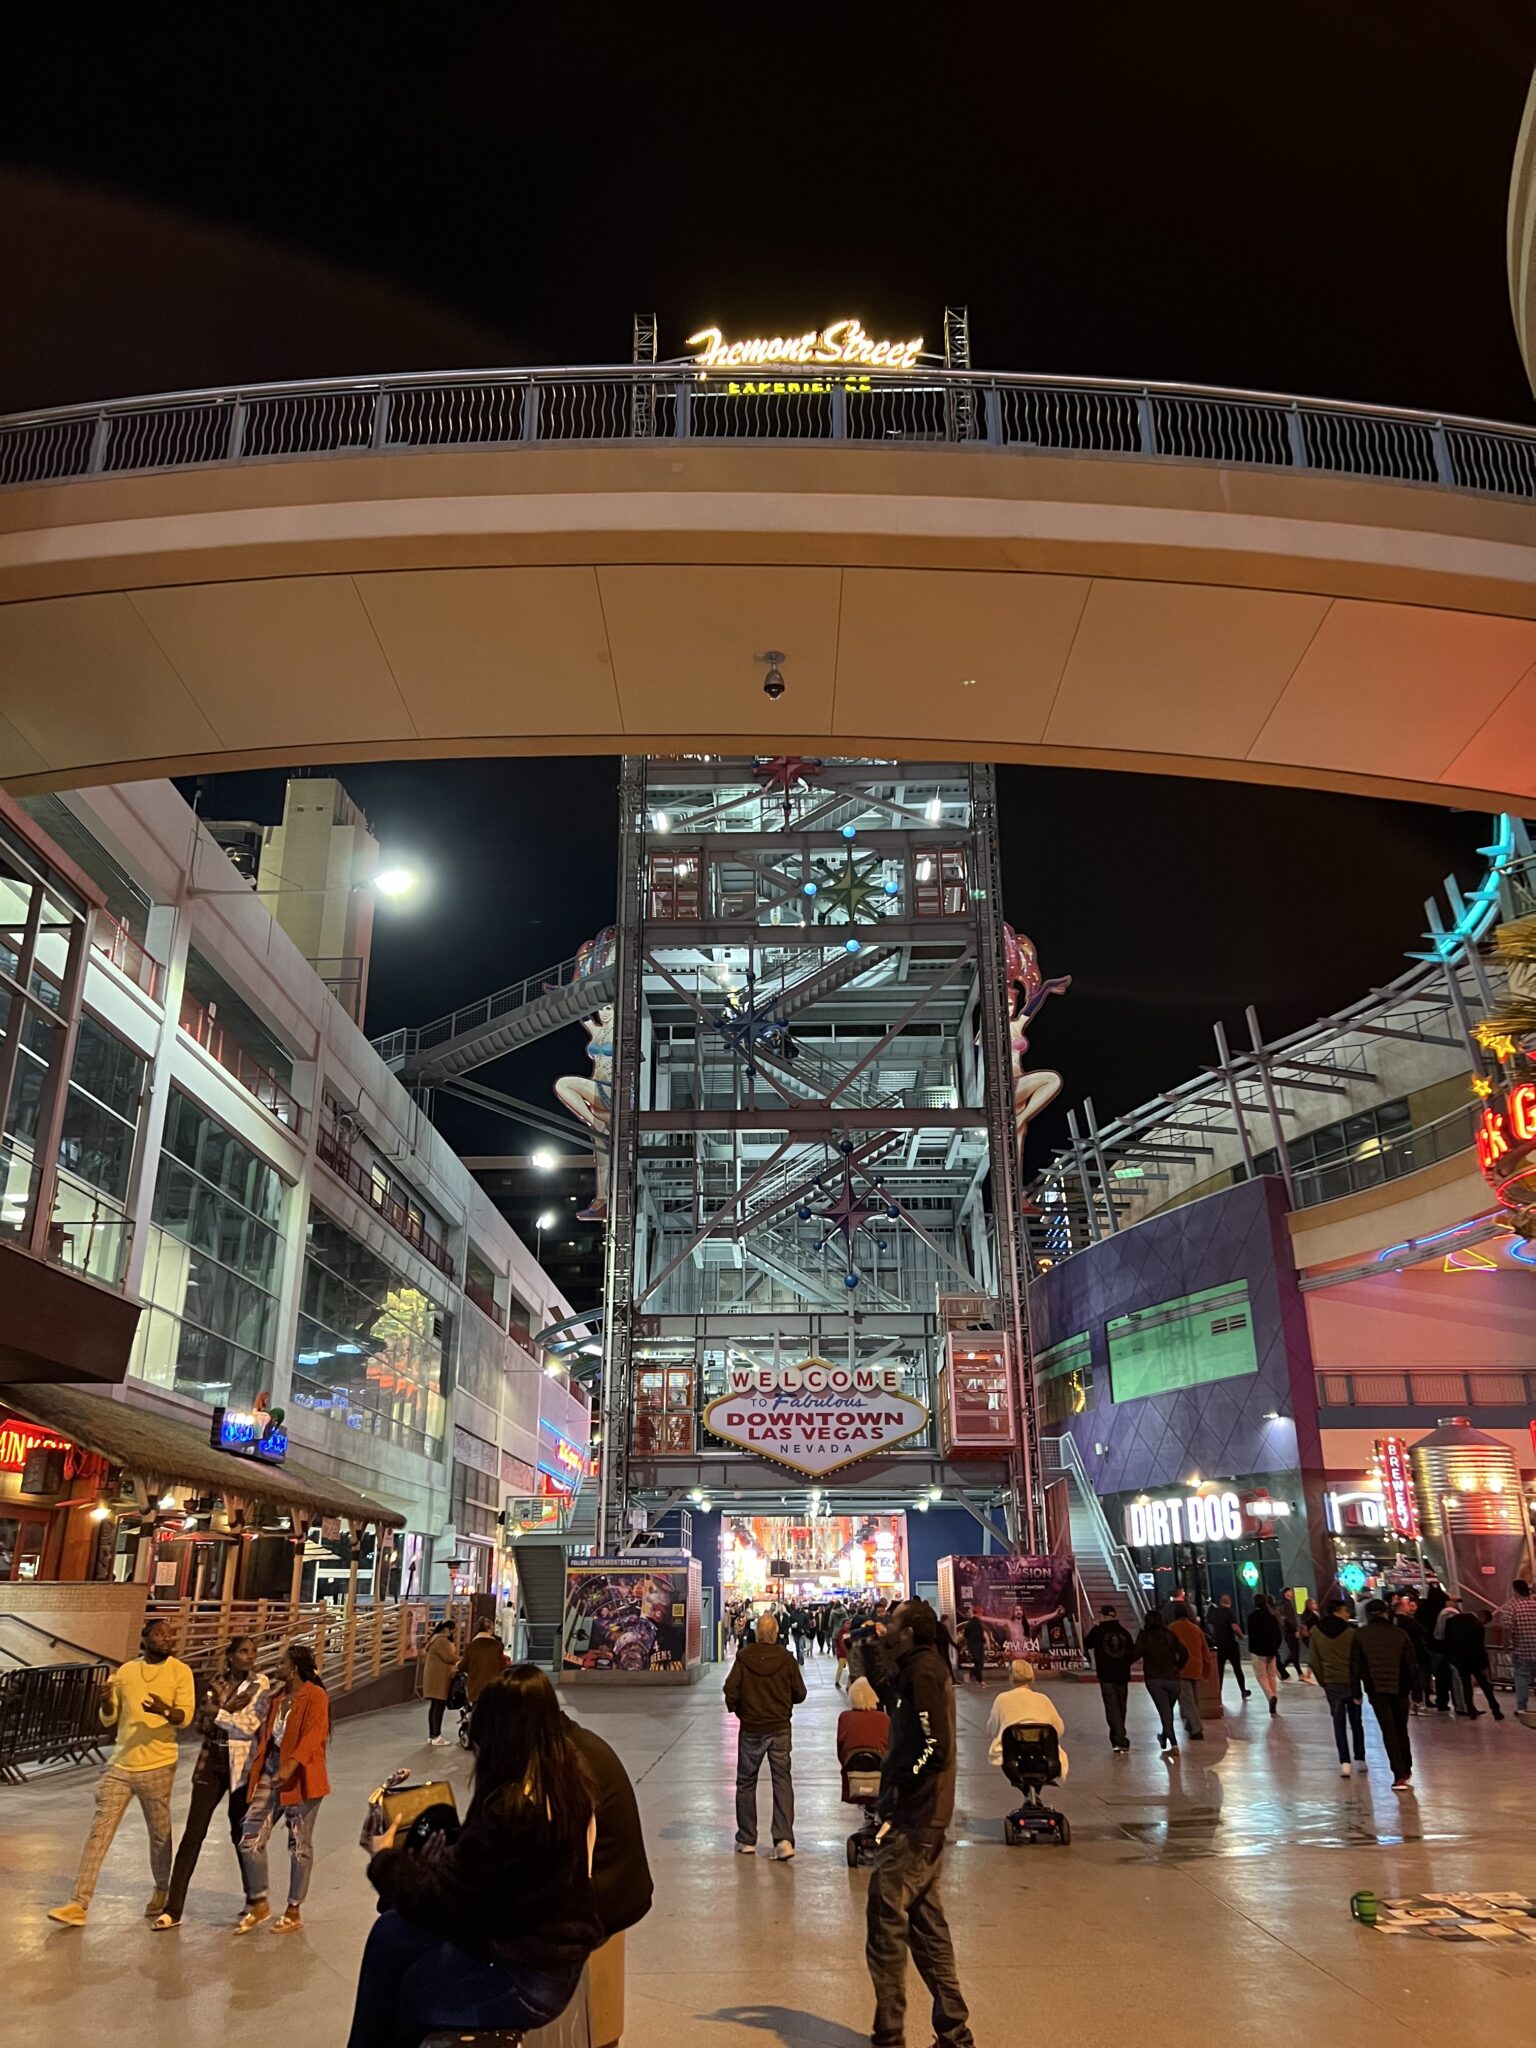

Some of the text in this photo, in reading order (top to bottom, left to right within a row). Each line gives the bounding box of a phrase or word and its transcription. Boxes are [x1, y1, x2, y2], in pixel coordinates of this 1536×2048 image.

[686, 318, 924, 369] Fremont Street
[732, 1371, 896, 1387] WELCOME
[752, 1391, 868, 1412] TO Fabulous
[726, 1412, 904, 1427] DOWNTOWN
[748, 1427, 884, 1441] LAS VEGAS
[780, 1444, 852, 1454] NEVADA
[1387, 1444, 1410, 1529] BREWERY
[1130, 1492, 1243, 1547] DIRT DOG
